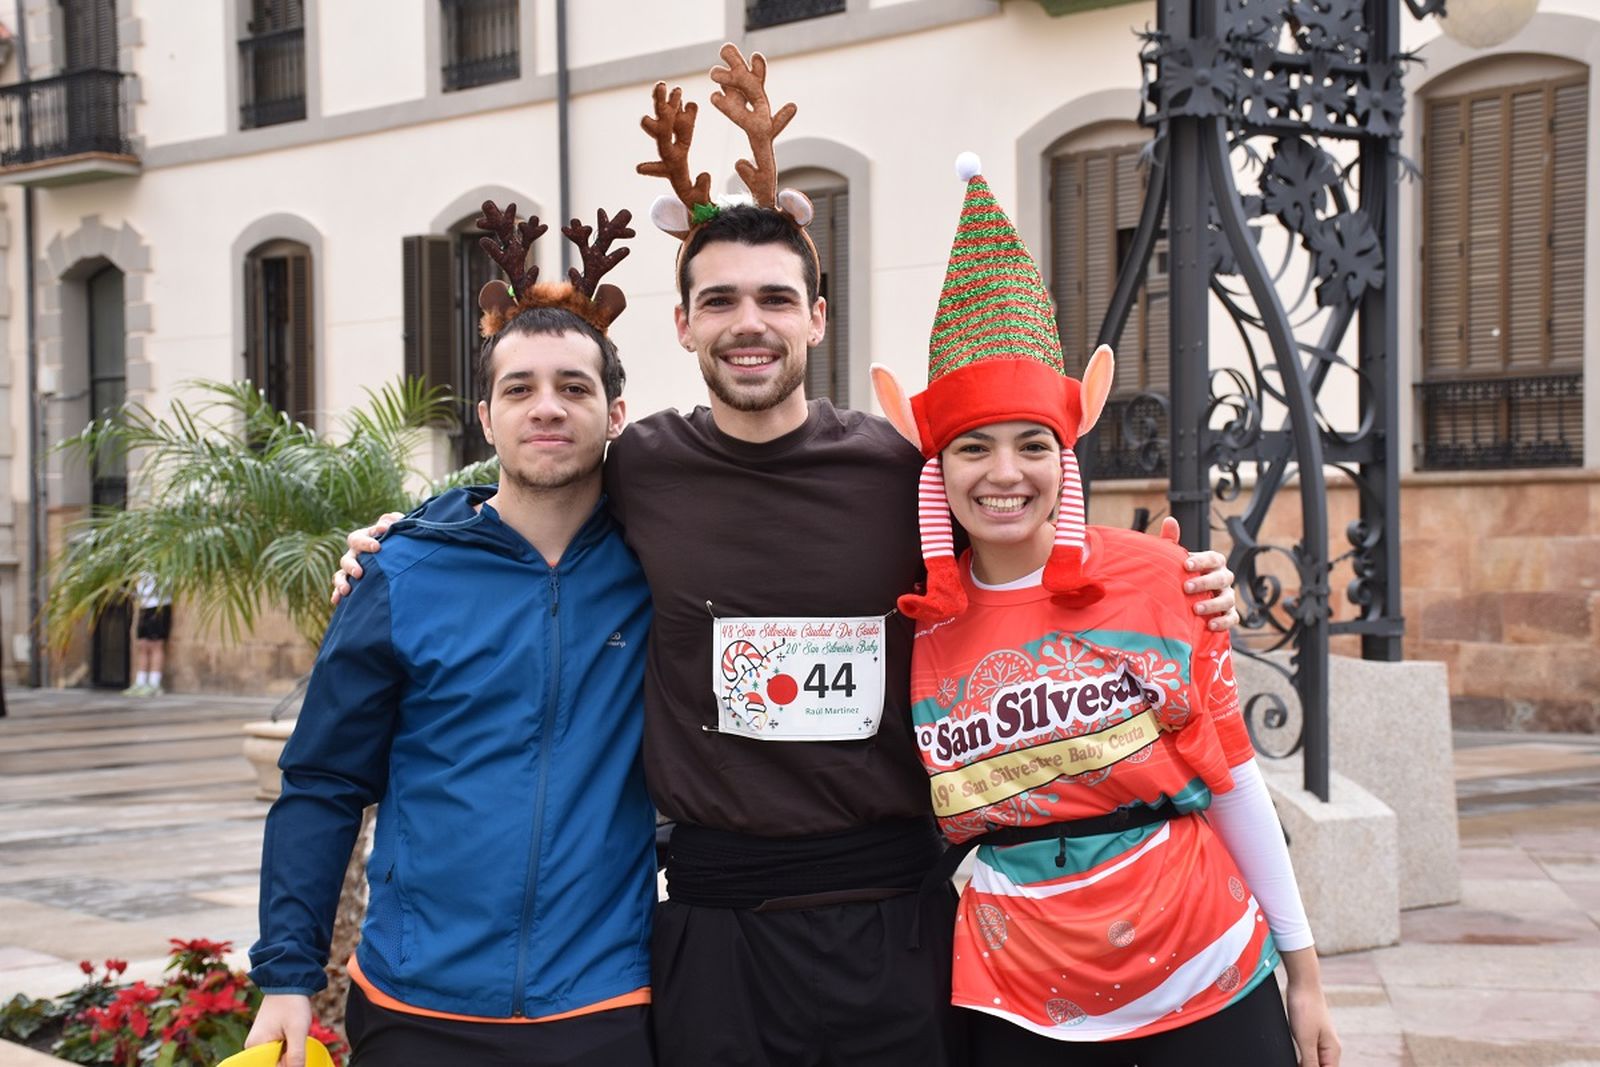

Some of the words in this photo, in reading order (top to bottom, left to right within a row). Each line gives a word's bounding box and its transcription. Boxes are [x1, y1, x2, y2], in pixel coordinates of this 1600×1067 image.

[737, 623, 756, 639] San
[759, 623, 797, 639] Silvestre
[801, 623, 835, 638] Ciudad
[836, 623, 852, 639] De
[856, 622, 880, 638] Ceuta
[802, 641, 819, 655] San
[822, 641, 853, 655] Silvestre
[856, 640, 878, 654] Baby
[803, 662, 857, 698] 44
[936, 717, 992, 761] San
[934, 783, 956, 809] 19º
[962, 780, 988, 798] San
[989, 752, 1063, 787] Silvestre
[1067, 741, 1104, 765] Baby
[1108, 725, 1145, 751] Ceuta
